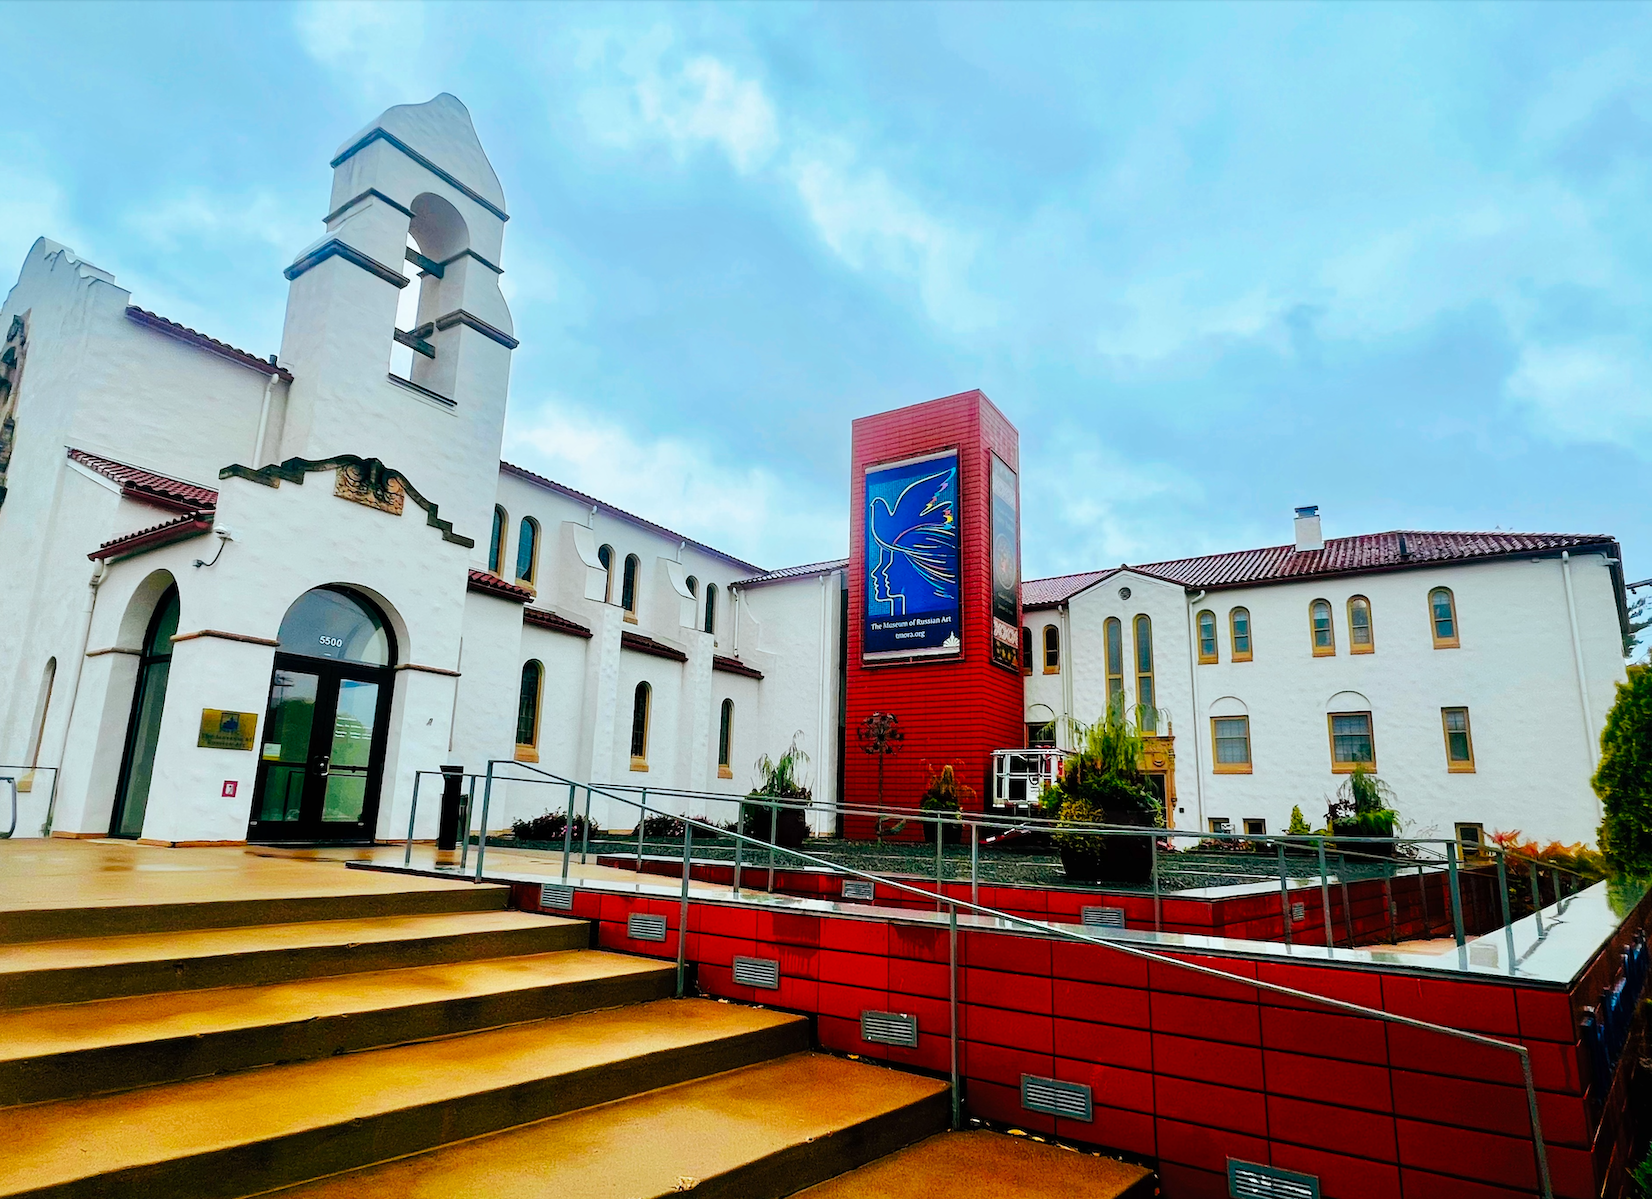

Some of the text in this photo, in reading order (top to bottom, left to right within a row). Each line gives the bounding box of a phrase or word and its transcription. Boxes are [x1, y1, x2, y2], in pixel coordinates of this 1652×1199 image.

[883, 621, 908, 629] Museum
[916, 617, 940, 626] Russian
[895, 631, 925, 639] tmora.org
[319, 635, 343, 648] 5500
